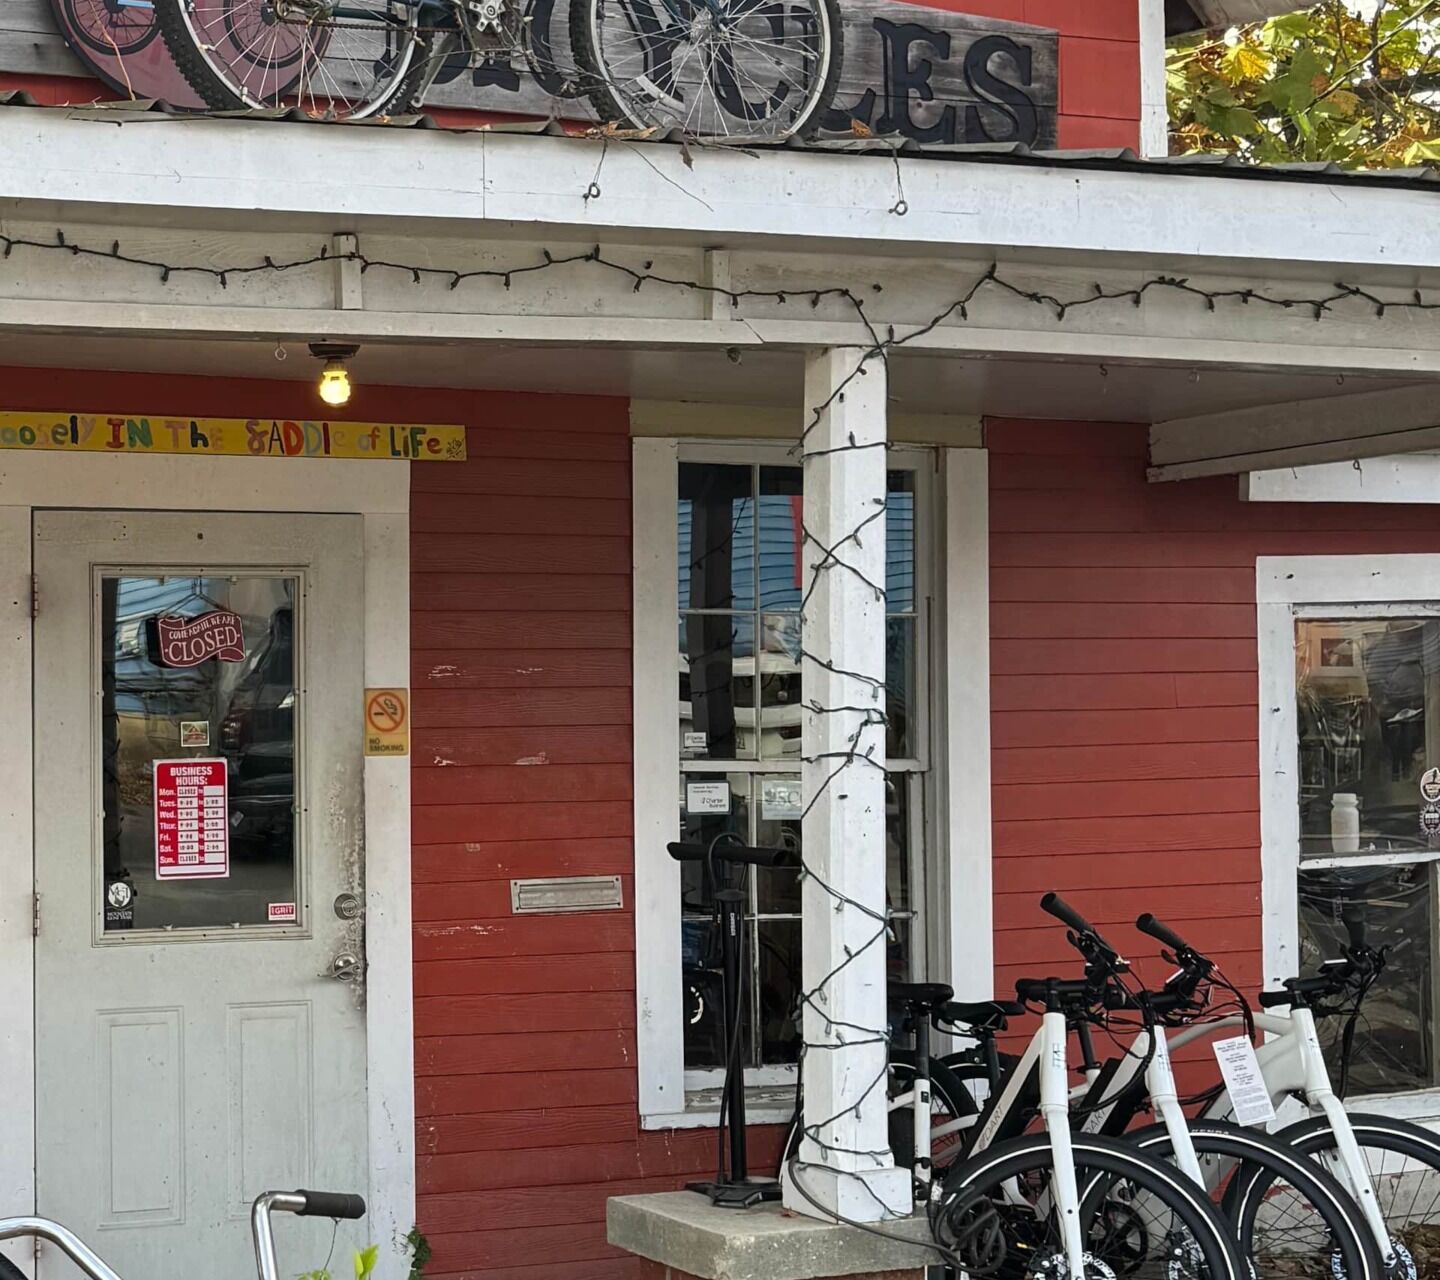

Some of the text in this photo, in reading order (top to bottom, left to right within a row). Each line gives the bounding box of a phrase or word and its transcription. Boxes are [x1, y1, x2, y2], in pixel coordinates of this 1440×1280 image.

[106, 417, 153, 449] IN
[356, 426, 380, 452] of
[168, 626, 238, 662] CLOSED
[369, 737, 381, 745] NO
[369, 744, 404, 752] SMOKING
[170, 766, 213, 777] BUSINESS
[175, 776, 208, 786] HOURS:
